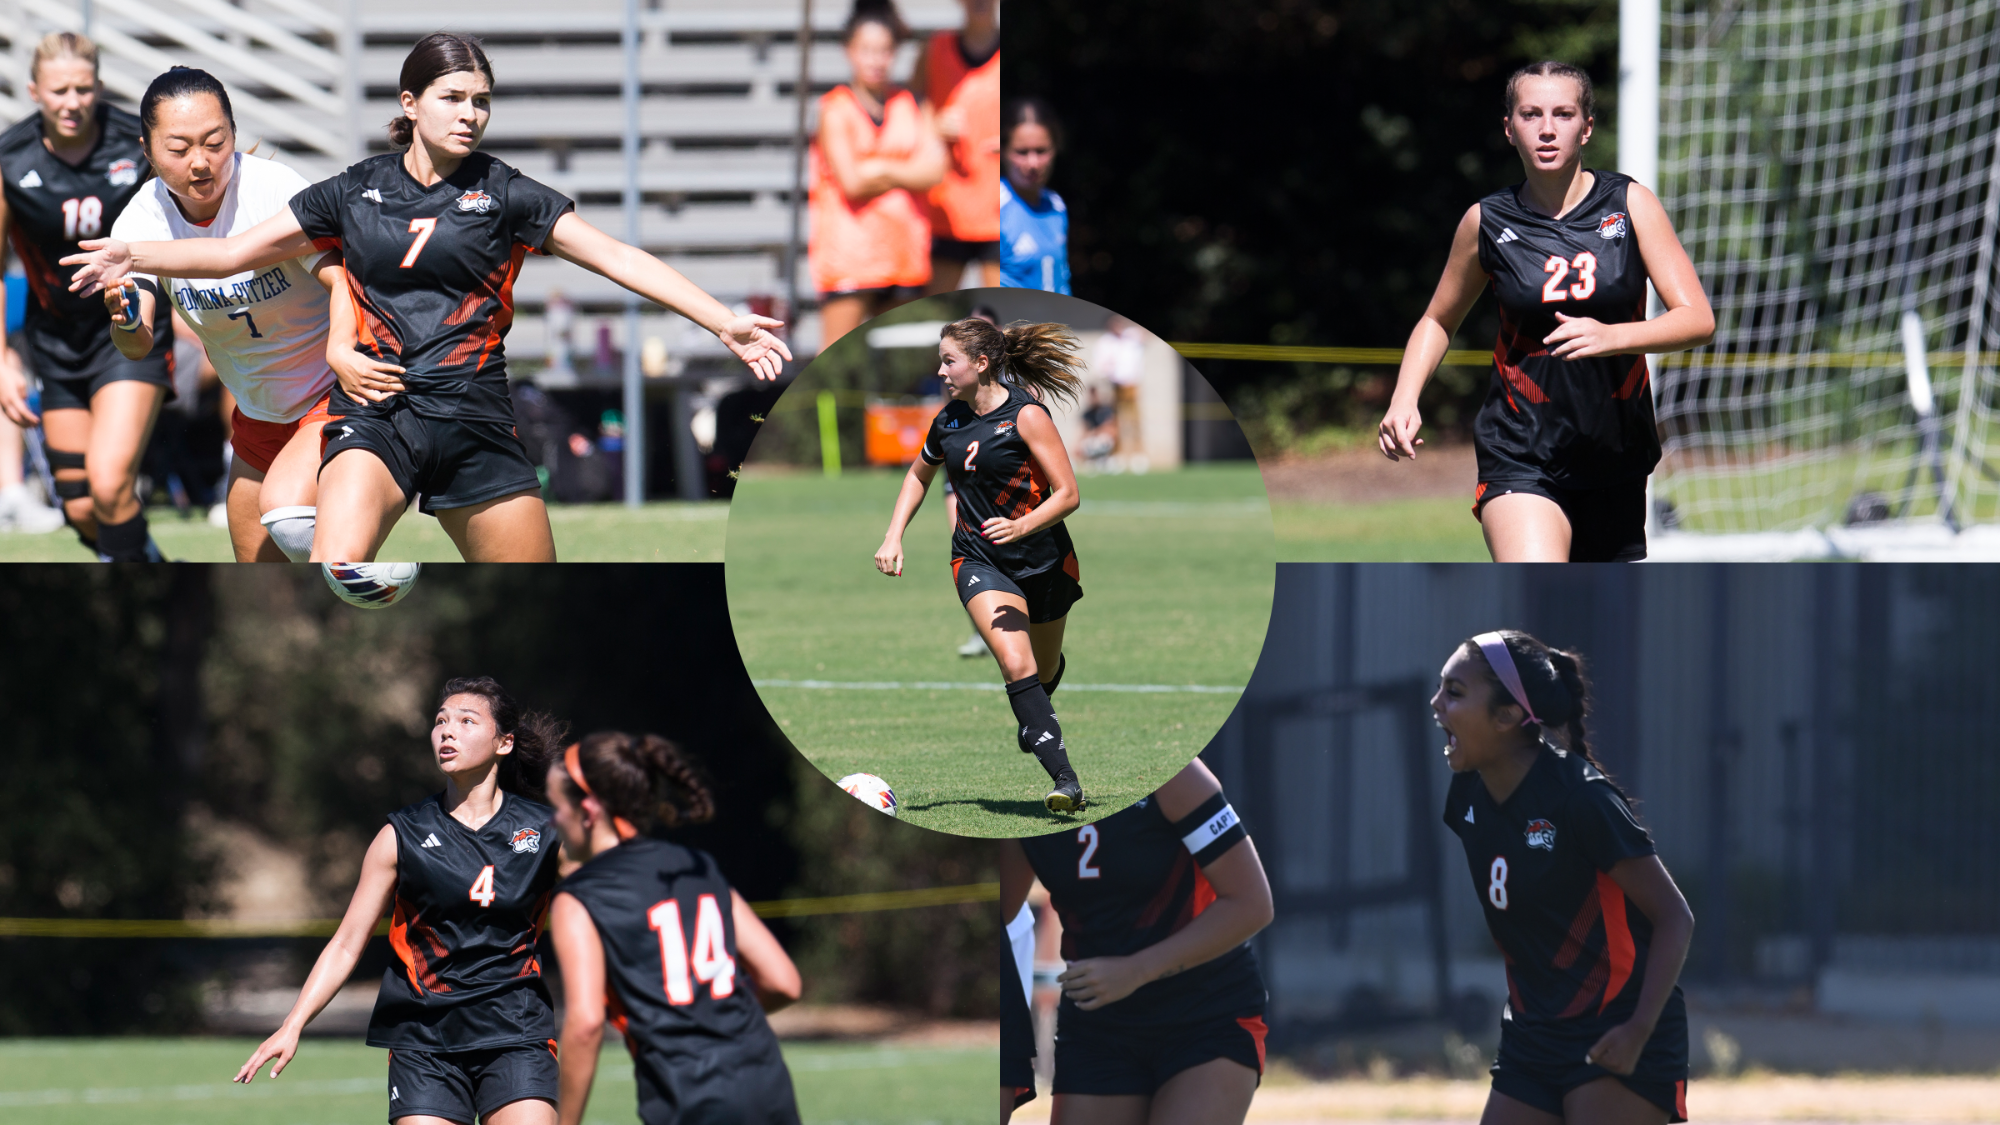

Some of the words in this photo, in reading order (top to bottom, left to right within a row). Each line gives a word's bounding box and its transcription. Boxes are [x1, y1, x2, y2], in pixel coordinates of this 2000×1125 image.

[62, 195, 103, 240] 18
[399, 217, 438, 269] 7
[175, 266, 292, 311] POMONA-PITZER
[1542, 250, 1597, 303] 23
[227, 313, 263, 338] 7
[964, 440, 980, 472] 2
[1077, 822, 1101, 879] 2
[468, 864, 496, 908] 4
[1488, 854, 1509, 911] 8
[646, 893, 736, 1007] 14
